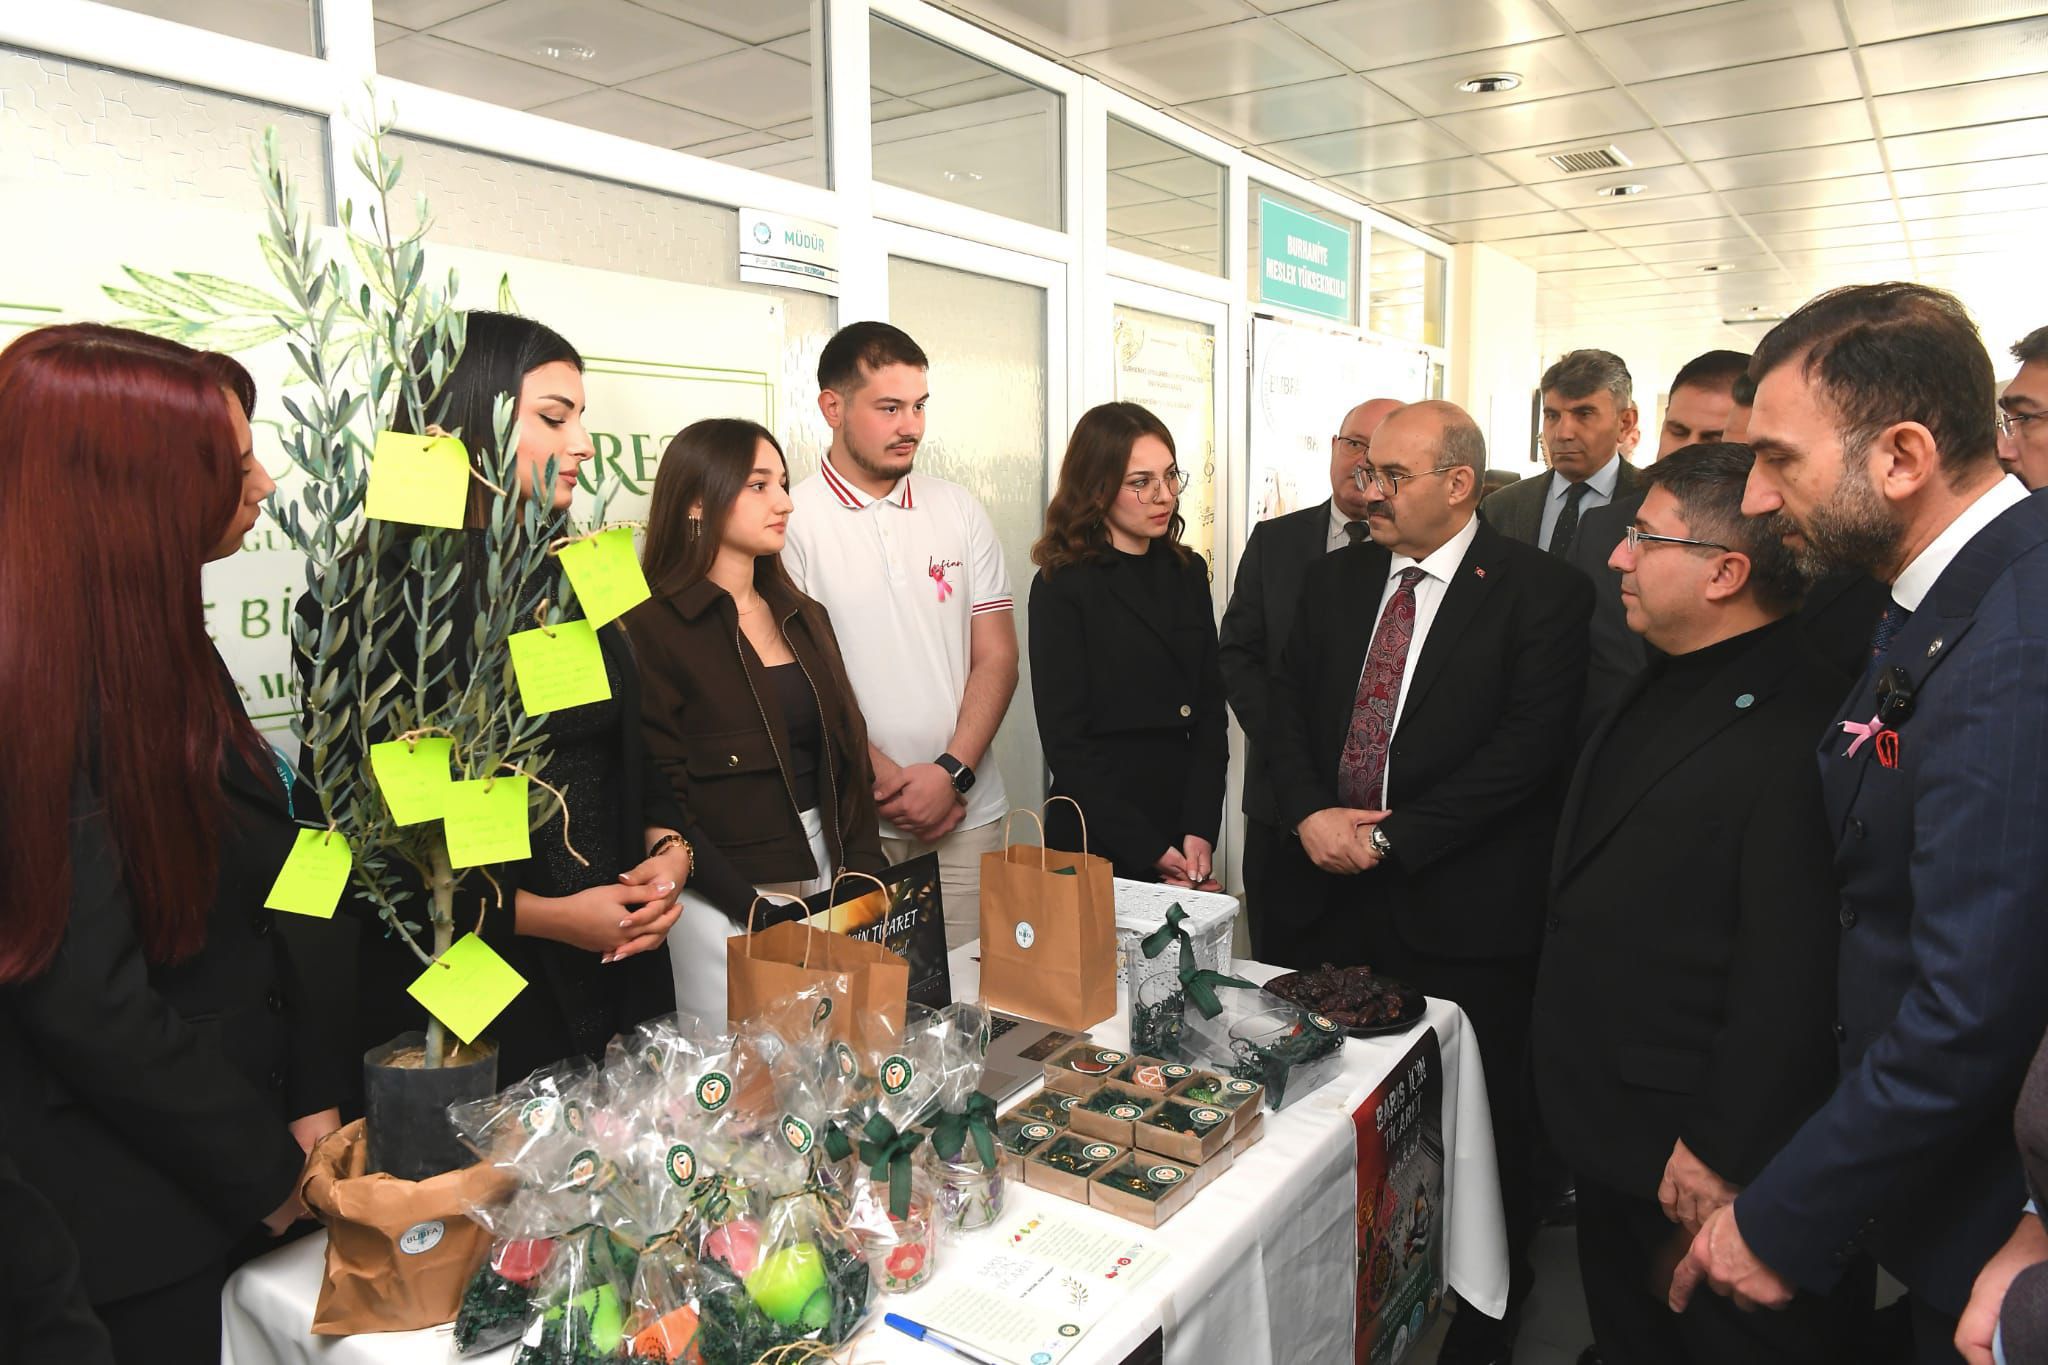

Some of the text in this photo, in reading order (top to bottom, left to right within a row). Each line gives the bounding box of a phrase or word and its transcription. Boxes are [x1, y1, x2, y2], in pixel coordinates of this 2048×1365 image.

[784, 229, 825, 253] MÜDÜR
[1287, 234, 1329, 267] BURHANİYE
[1266, 257, 1346, 300] MESLEK YÜKSEKOKULU
